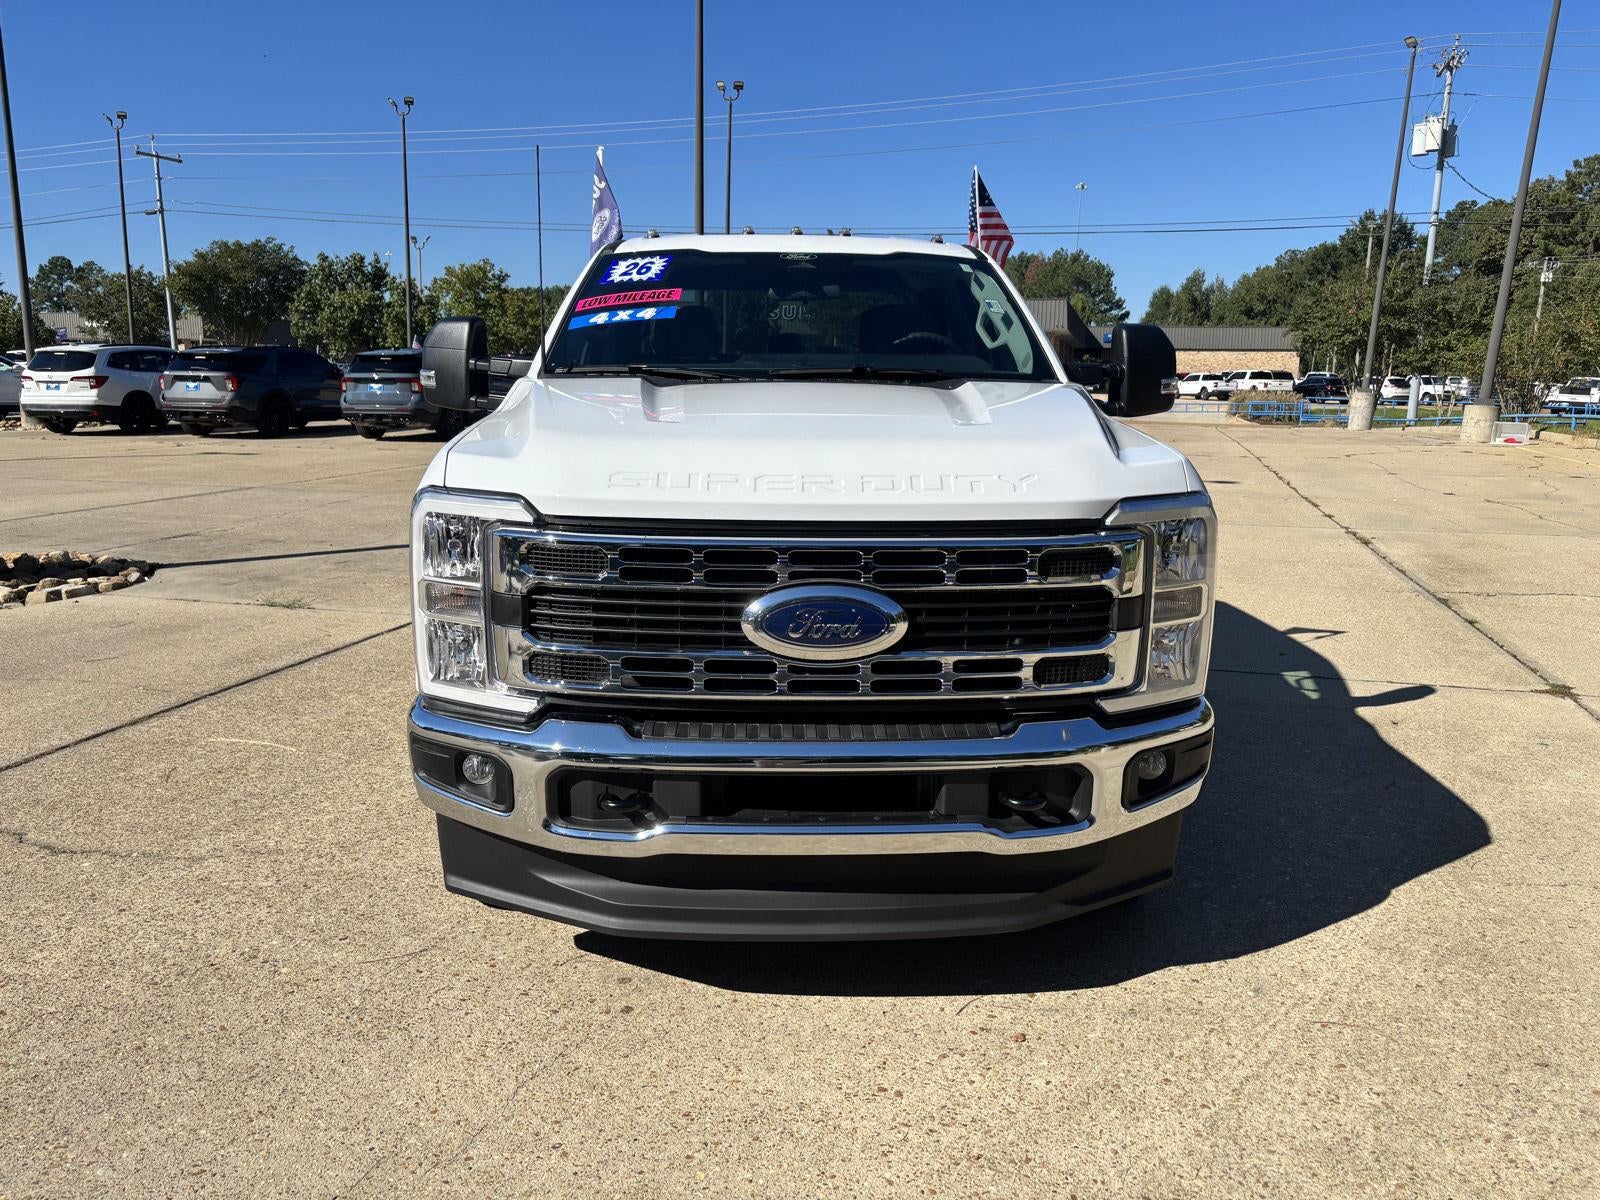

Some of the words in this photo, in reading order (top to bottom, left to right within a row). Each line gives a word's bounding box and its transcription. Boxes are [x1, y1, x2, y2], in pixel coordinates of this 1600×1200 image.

[619, 261, 656, 277] 26
[581, 296, 612, 309] LOW
[613, 289, 676, 304] MILEAGE
[607, 469, 845, 494] SUPER
[859, 471, 1041, 495] DUTY
[787, 608, 863, 639] Ford
